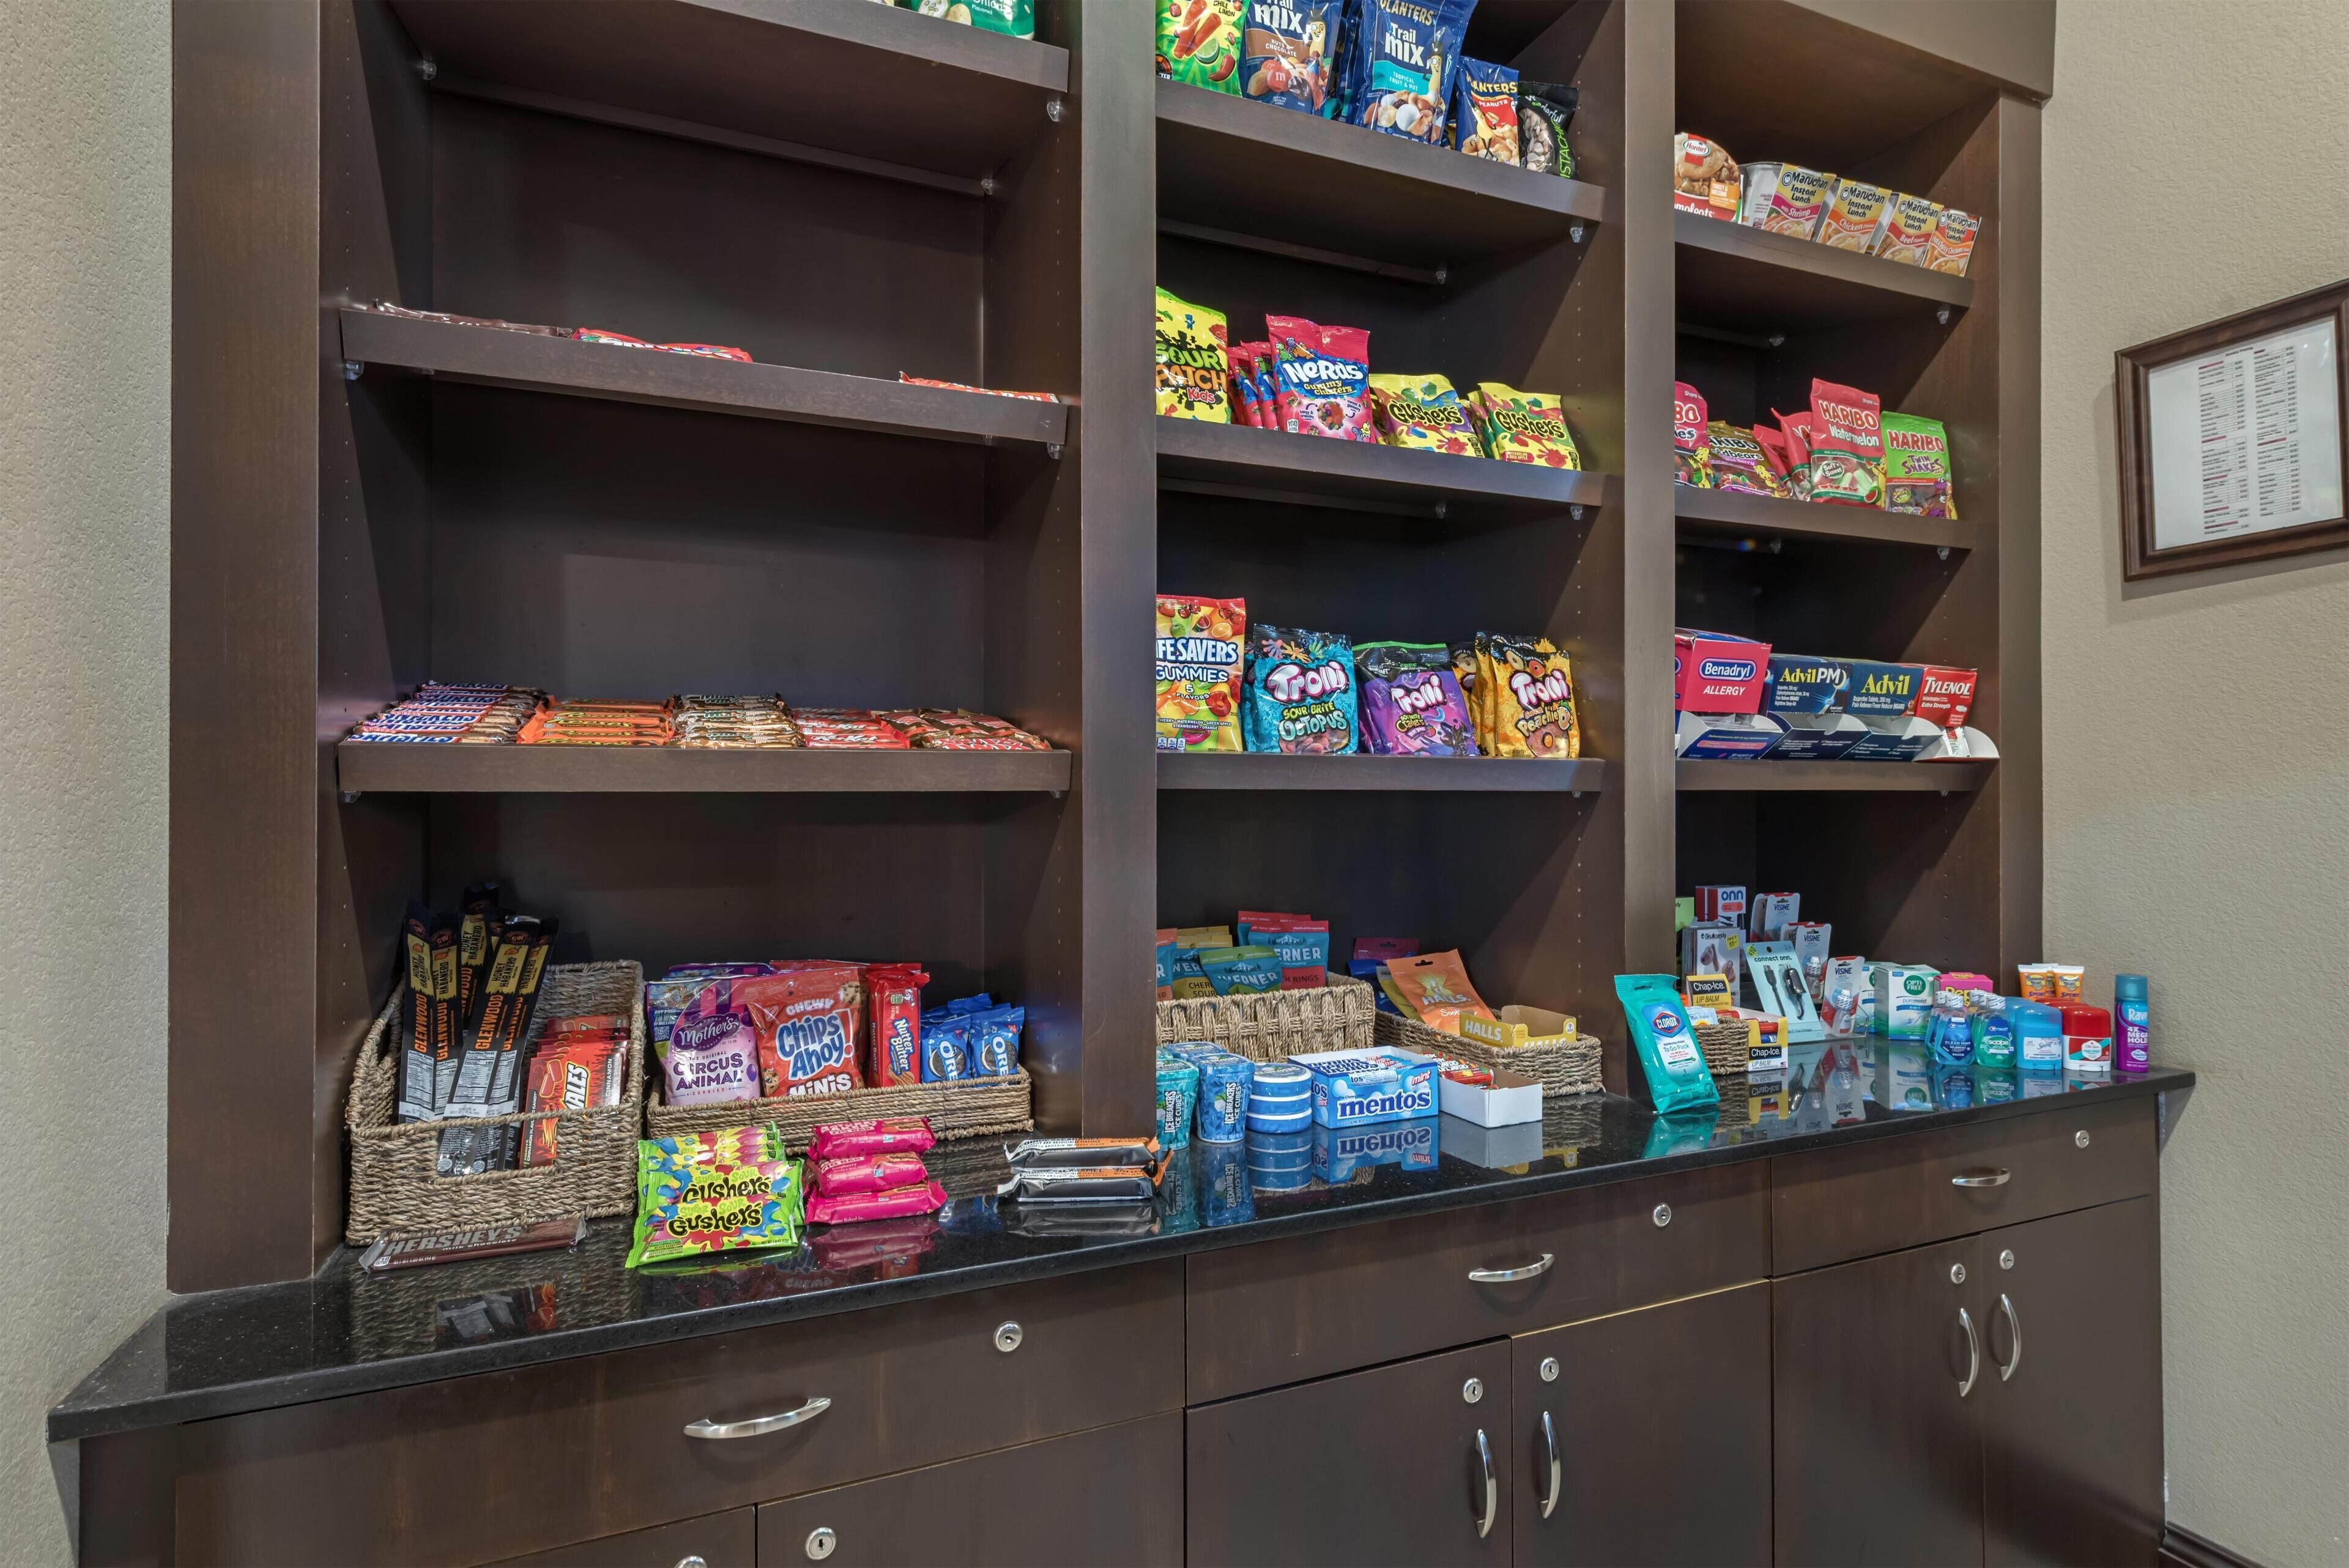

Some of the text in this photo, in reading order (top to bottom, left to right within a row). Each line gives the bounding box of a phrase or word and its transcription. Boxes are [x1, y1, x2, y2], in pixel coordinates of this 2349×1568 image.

[972, 4, 992, 15] Flavored
[1214, 0, 1228, 9] CHILE
[1254, 4, 1303, 33] mix
[1390, 23, 1416, 43] Trail
[1265, 43, 1297, 57] CHOCOLATE
[1385, 32, 1424, 67] mix
[1390, 76, 1403, 86] FRUIT
[1409, 82, 1419, 91] NUT
[1393, 72, 1415, 84] TROPICAL
[1686, 142, 1707, 153] Hormel
[1792, 171, 1828, 190] Maruchan
[1791, 185, 1816, 196] Instant
[1791, 193, 1811, 204] Lunch
[1849, 187, 1885, 204] Maruchan
[1788, 208, 1811, 218] Shrimp
[1847, 199, 1872, 211] Instant
[1847, 207, 1866, 218] Lunch
[1906, 201, 1939, 218] Maruchan
[1839, 219, 1863, 231] Chicken
[1904, 220, 1922, 232] Lunch
[1905, 212, 1928, 225] Instant
[1946, 213, 1976, 230] Maruchan
[1946, 224, 1966, 236] Instant
[1946, 232, 1962, 242] Lunch
[1899, 235, 1914, 244] Beef
[1156, 343, 1220, 370] SOUR
[1156, 364, 1227, 392] PATCH
[1304, 380, 1342, 390] Gummy
[1186, 387, 1216, 404] Kids
[1315, 385, 1353, 395] Clusters
[1685, 390, 1698, 399] Share
[1818, 400, 1879, 429] HARIBO
[1828, 423, 1880, 447] Watermelon
[1887, 429, 1945, 454] HARIBO
[1824, 462, 1836, 470] Soft
[1901, 459, 1944, 475] SNAKES
[1908, 455, 1931, 464] TWIN
[1825, 467, 1842, 477] Sweet
[1156, 666, 1228, 682] GUMMIES
[1705, 663, 1751, 677] Benadryl
[1779, 667, 1841, 683] Advil PM
[1267, 661, 1346, 700] Trolli
[1511, 670, 1568, 704] Trolli
[1860, 673, 1910, 695] Advil
[1924, 677, 1971, 695] TYLENOL
[1390, 674, 1444, 713] Trolli
[1703, 685, 1746, 696] ALLERGY
[1283, 706, 1308, 719] SOUR
[461, 931, 472, 953] HONEY
[468, 925, 483, 960] HABANERO
[1274, 948, 1321, 961] ERNER
[439, 961, 449, 995] HABANERO
[492, 962, 506, 982] HONEY
[500, 957, 517, 987] HABANERO
[1293, 974, 1318, 983] RINGS
[786, 998, 834, 1016] CHEWY
[1421, 994, 1468, 1006] HALLS
[415, 994, 428, 1053] GLENWOOD
[475, 994, 503, 1050] GLENWOOD
[1656, 1017, 1678, 1028] CLOROX
[678, 1017, 739, 1046] Mother's
[778, 1014, 841, 1060] Chips
[894, 1019, 913, 1052] Nutter
[1465, 1020, 1502, 1041] HALLS
[891, 1036, 908, 1070] Butter
[675, 1071, 742, 1091] ANIMAL
[1411, 1069, 1431, 1085] mint
[1339, 1091, 1431, 1117] mentos
[669, 1203, 761, 1236] Gushers
[384, 1225, 522, 1257] HERSHEY'S
[467, 1238, 517, 1248] chocolate
